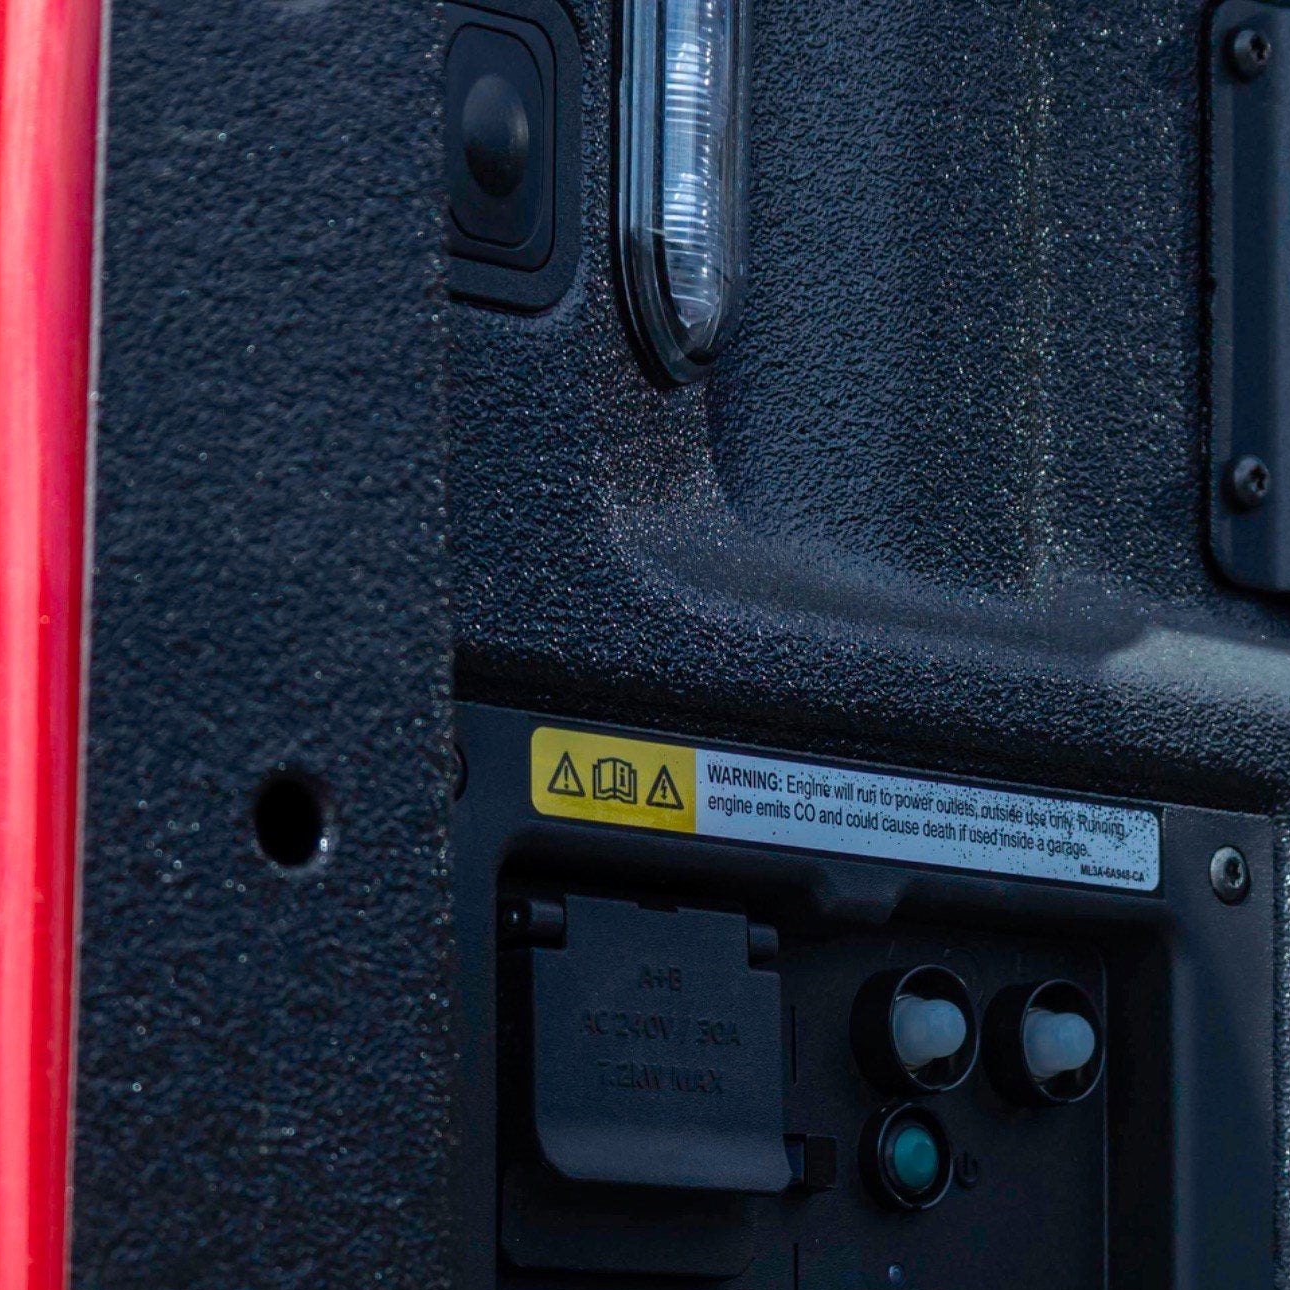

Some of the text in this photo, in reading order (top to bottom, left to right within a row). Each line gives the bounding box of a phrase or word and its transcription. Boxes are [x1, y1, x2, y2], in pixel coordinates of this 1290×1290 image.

[707, 764, 783, 792] WARNING:
[787, 775, 830, 800] Engine
[834, 782, 853, 801] will
[857, 787, 876, 804] run
[880, 788, 892, 806] to
[895, 793, 933, 811] power
[936, 797, 978, 820] outlets,
[981, 803, 1023, 825] outside
[1026, 811, 1047, 826] use
[708, 794, 1091, 860] engine emits CO and could cause death if used inside a garage.
